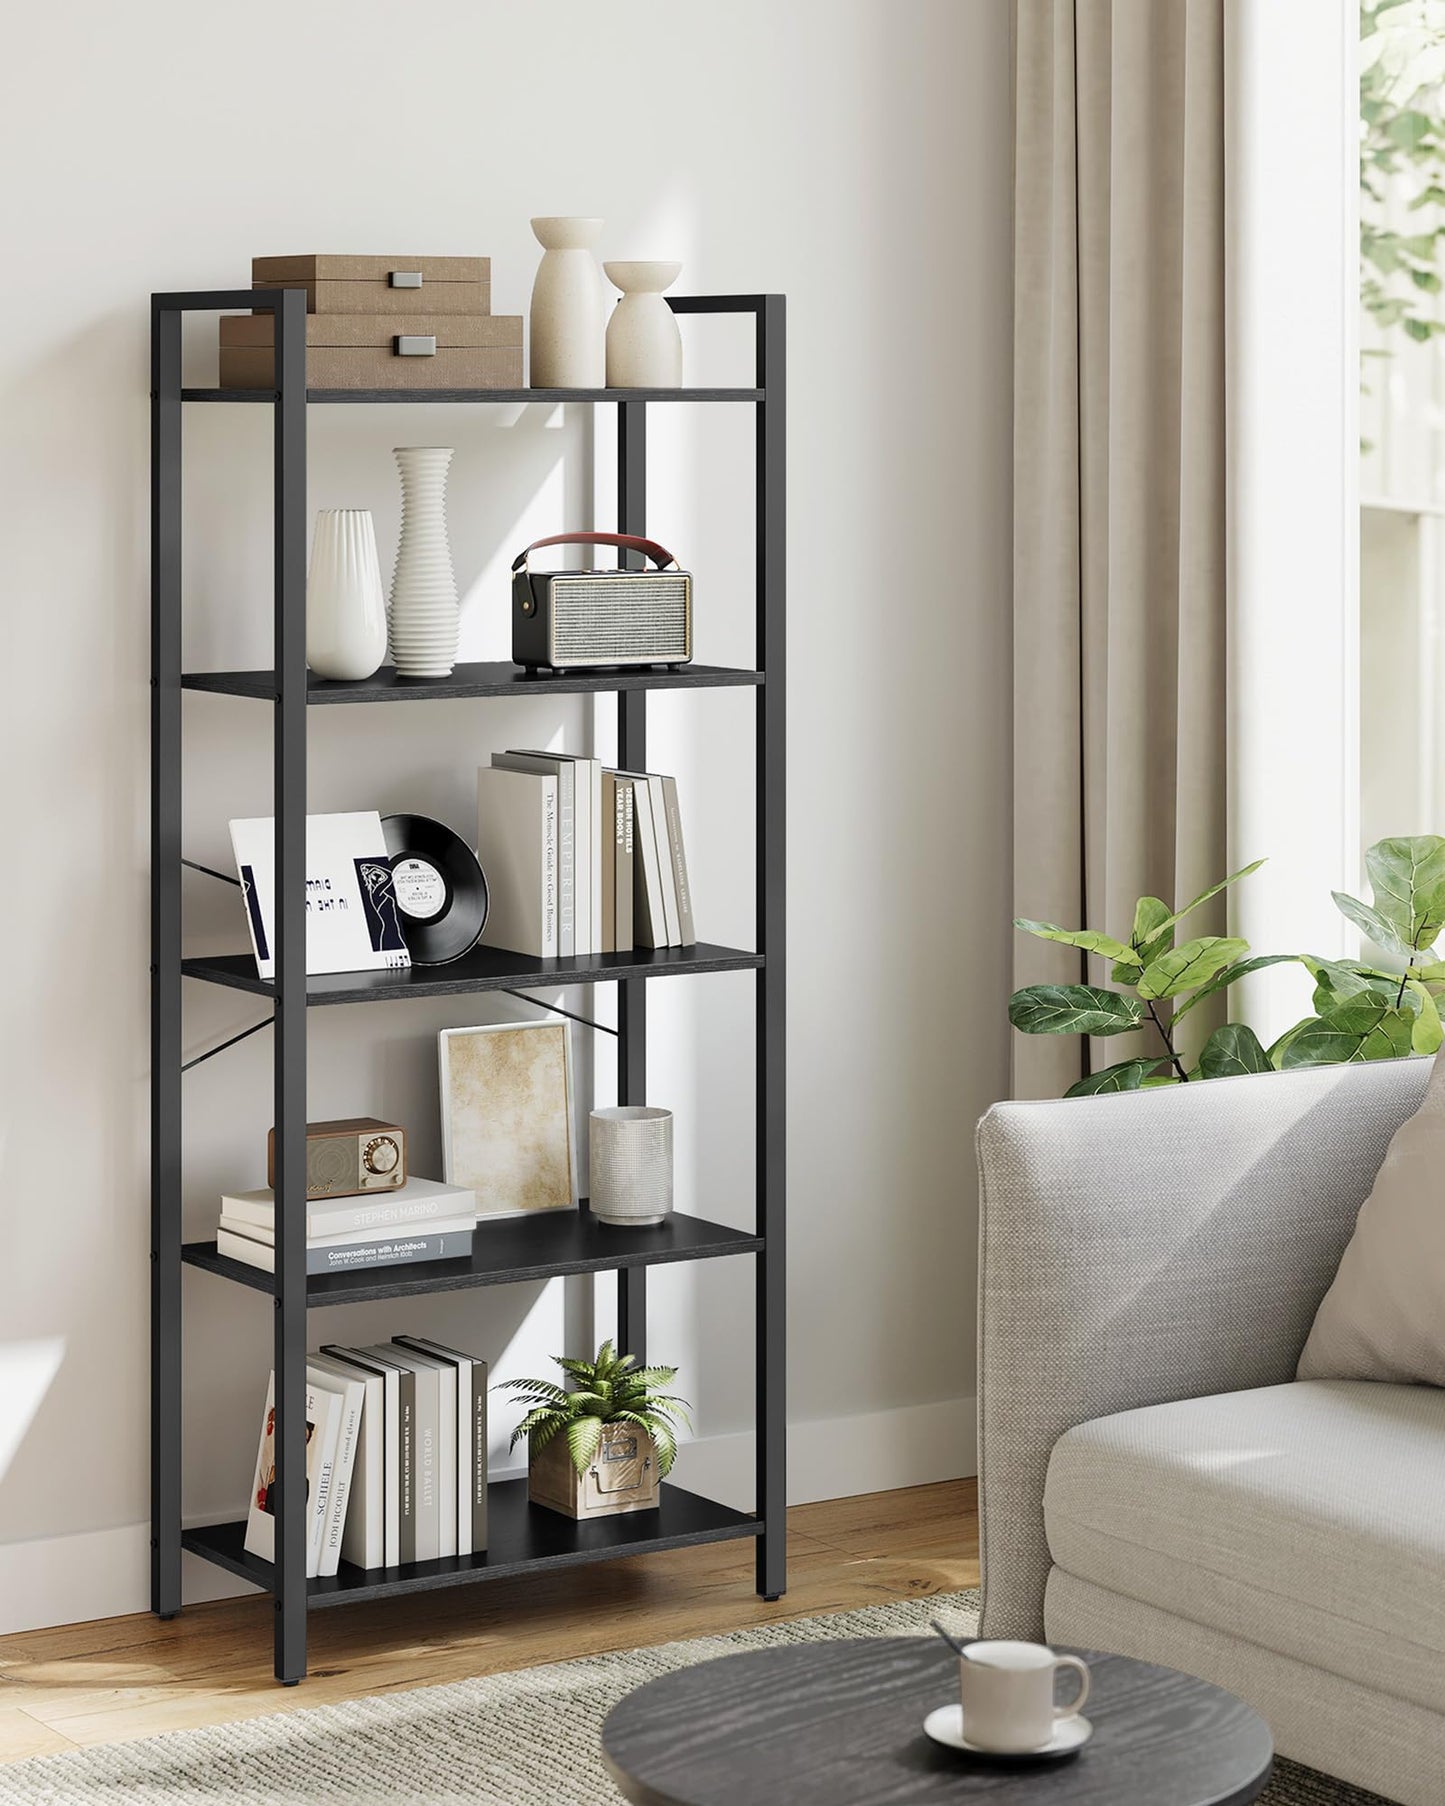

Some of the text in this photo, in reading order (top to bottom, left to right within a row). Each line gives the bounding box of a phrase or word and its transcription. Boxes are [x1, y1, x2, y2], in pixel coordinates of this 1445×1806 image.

[546, 793, 554, 942] The Monocle Guide to Good Business
[353, 1203, 438, 1225] STEPHEN MARINO
[328, 1247, 377, 1260] Conversations
[377, 1245, 393, 1254] with
[393, 1241, 427, 1252] Architects
[316, 1462, 332, 1515] SCHIELE
[329, 1409, 355, 1549] JODI PICOULT second glance
[423, 1428, 433, 1506] WORLD BALLET
